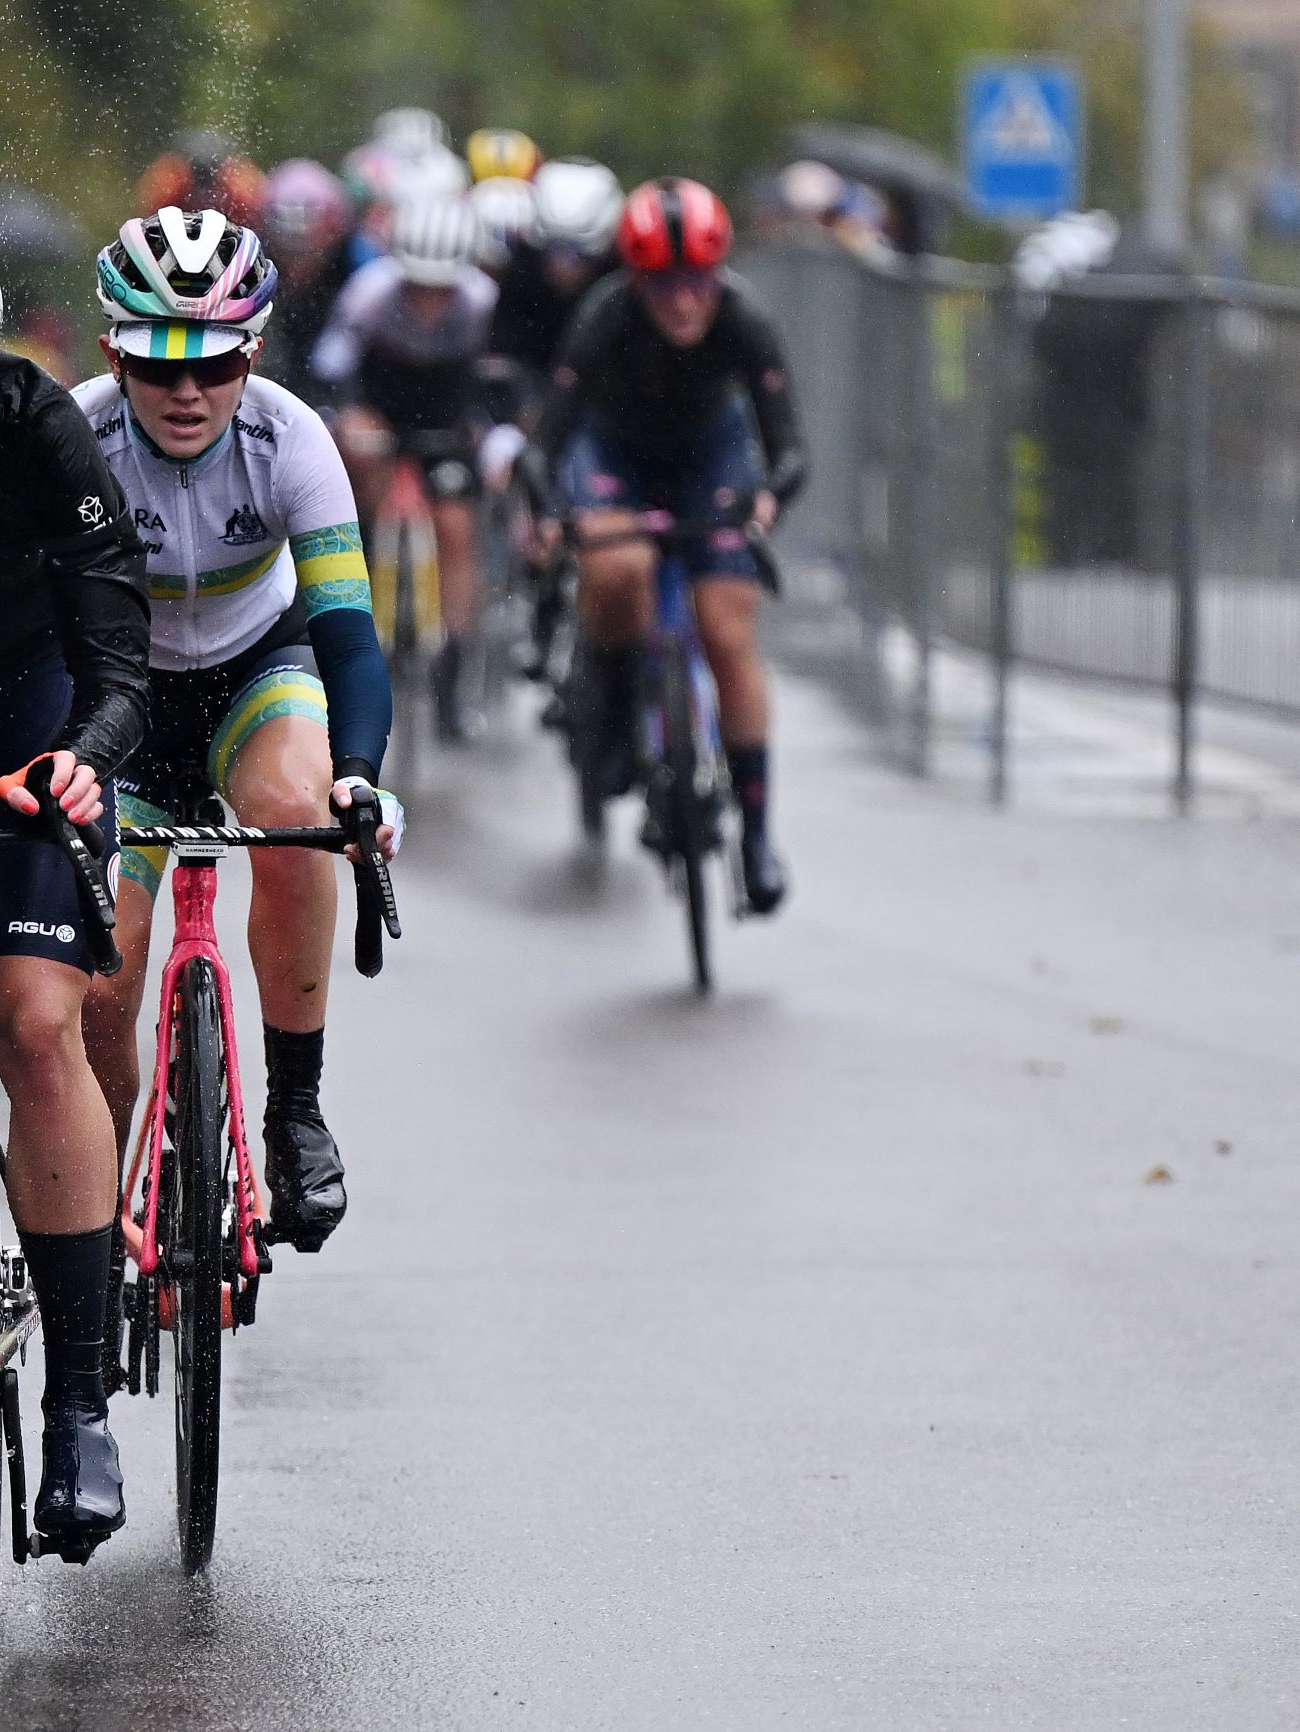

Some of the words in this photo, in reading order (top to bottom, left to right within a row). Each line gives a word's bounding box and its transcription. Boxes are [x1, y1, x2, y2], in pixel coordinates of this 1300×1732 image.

[175, 301, 206, 309] GIRO
[371, 852, 397, 917] SRAM
[7, 921, 57, 936] AGU
